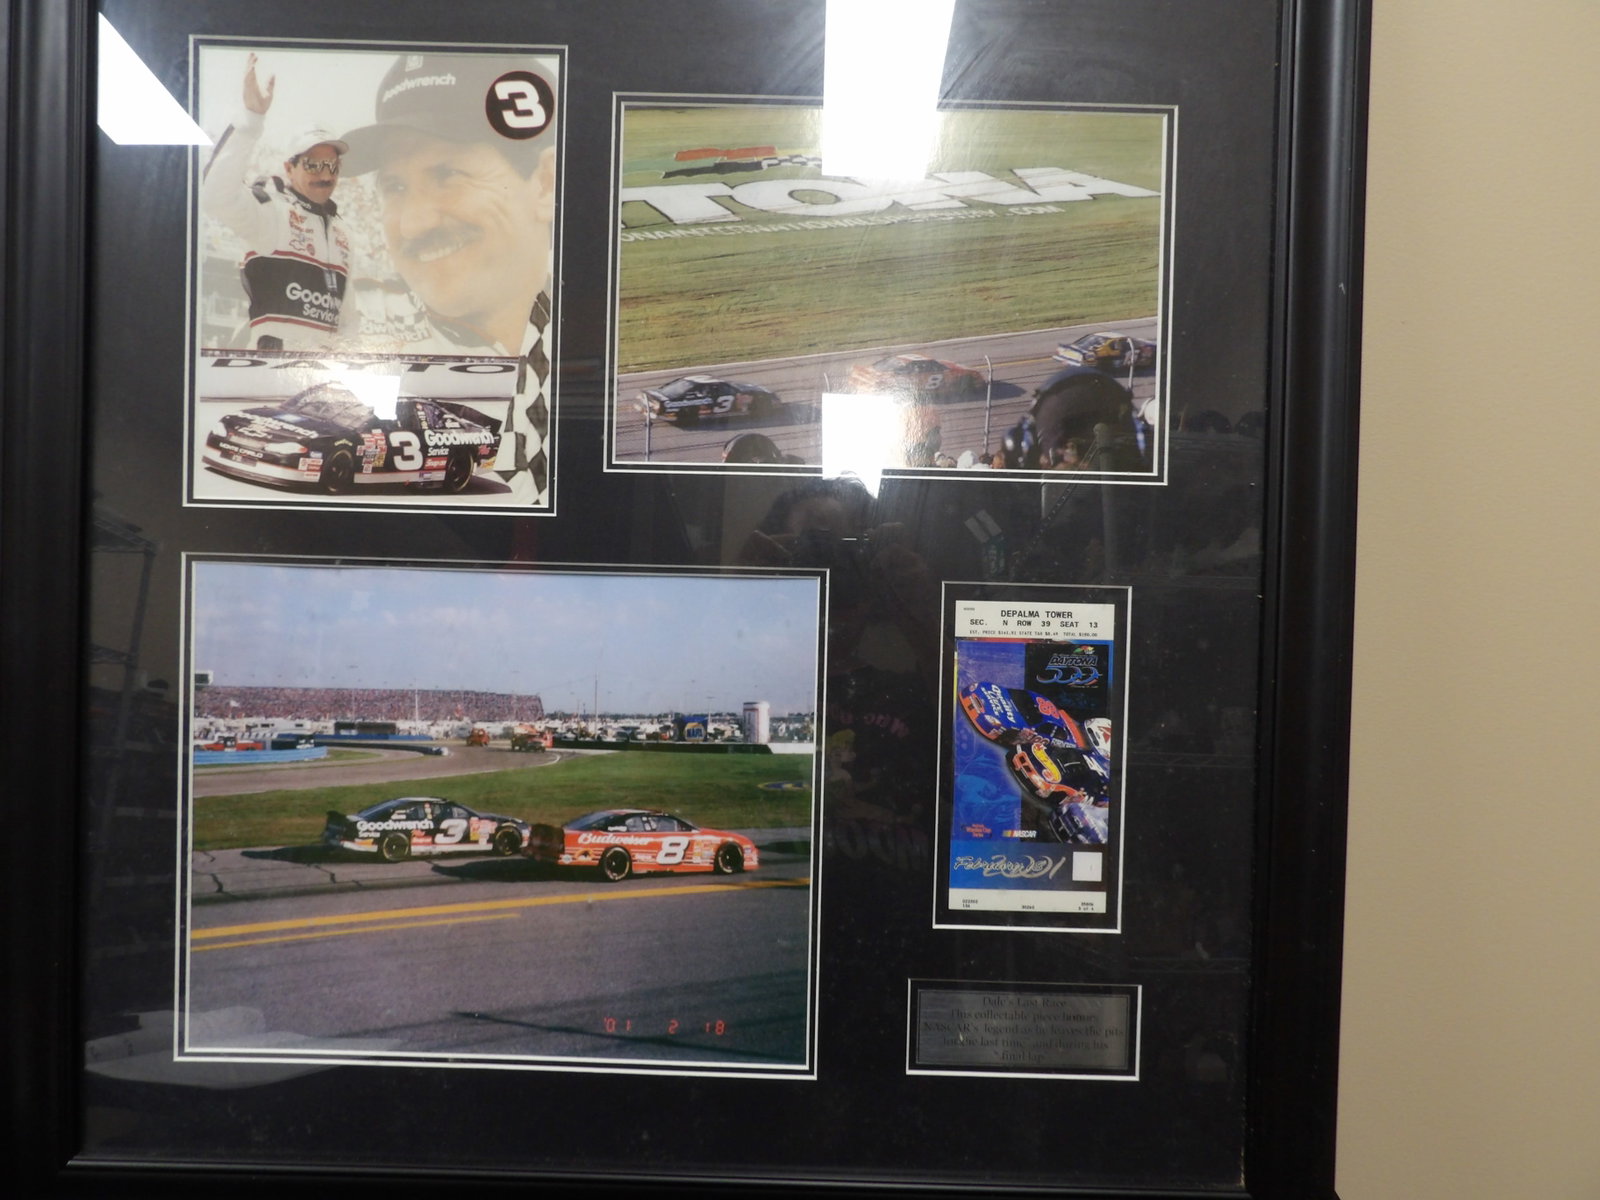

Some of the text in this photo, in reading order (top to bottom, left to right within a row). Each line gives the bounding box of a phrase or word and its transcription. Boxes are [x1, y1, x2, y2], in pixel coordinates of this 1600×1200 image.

[494, 80, 547, 129] 3
[713, 395, 735, 413] 3
[389, 431, 424, 471] 3
[969, 618, 988, 626] SEC.
[1000, 610, 1073, 618] DEPALMA TOWER
[1049, 656, 1098, 667] DAYTONA
[434, 818, 467, 844] 3
[1013, 830, 1037, 838] NASCAR
[656, 836, 690, 865] 8
[668, 1018, 679, 1035] 2
[705, 1019, 726, 1036] 18
